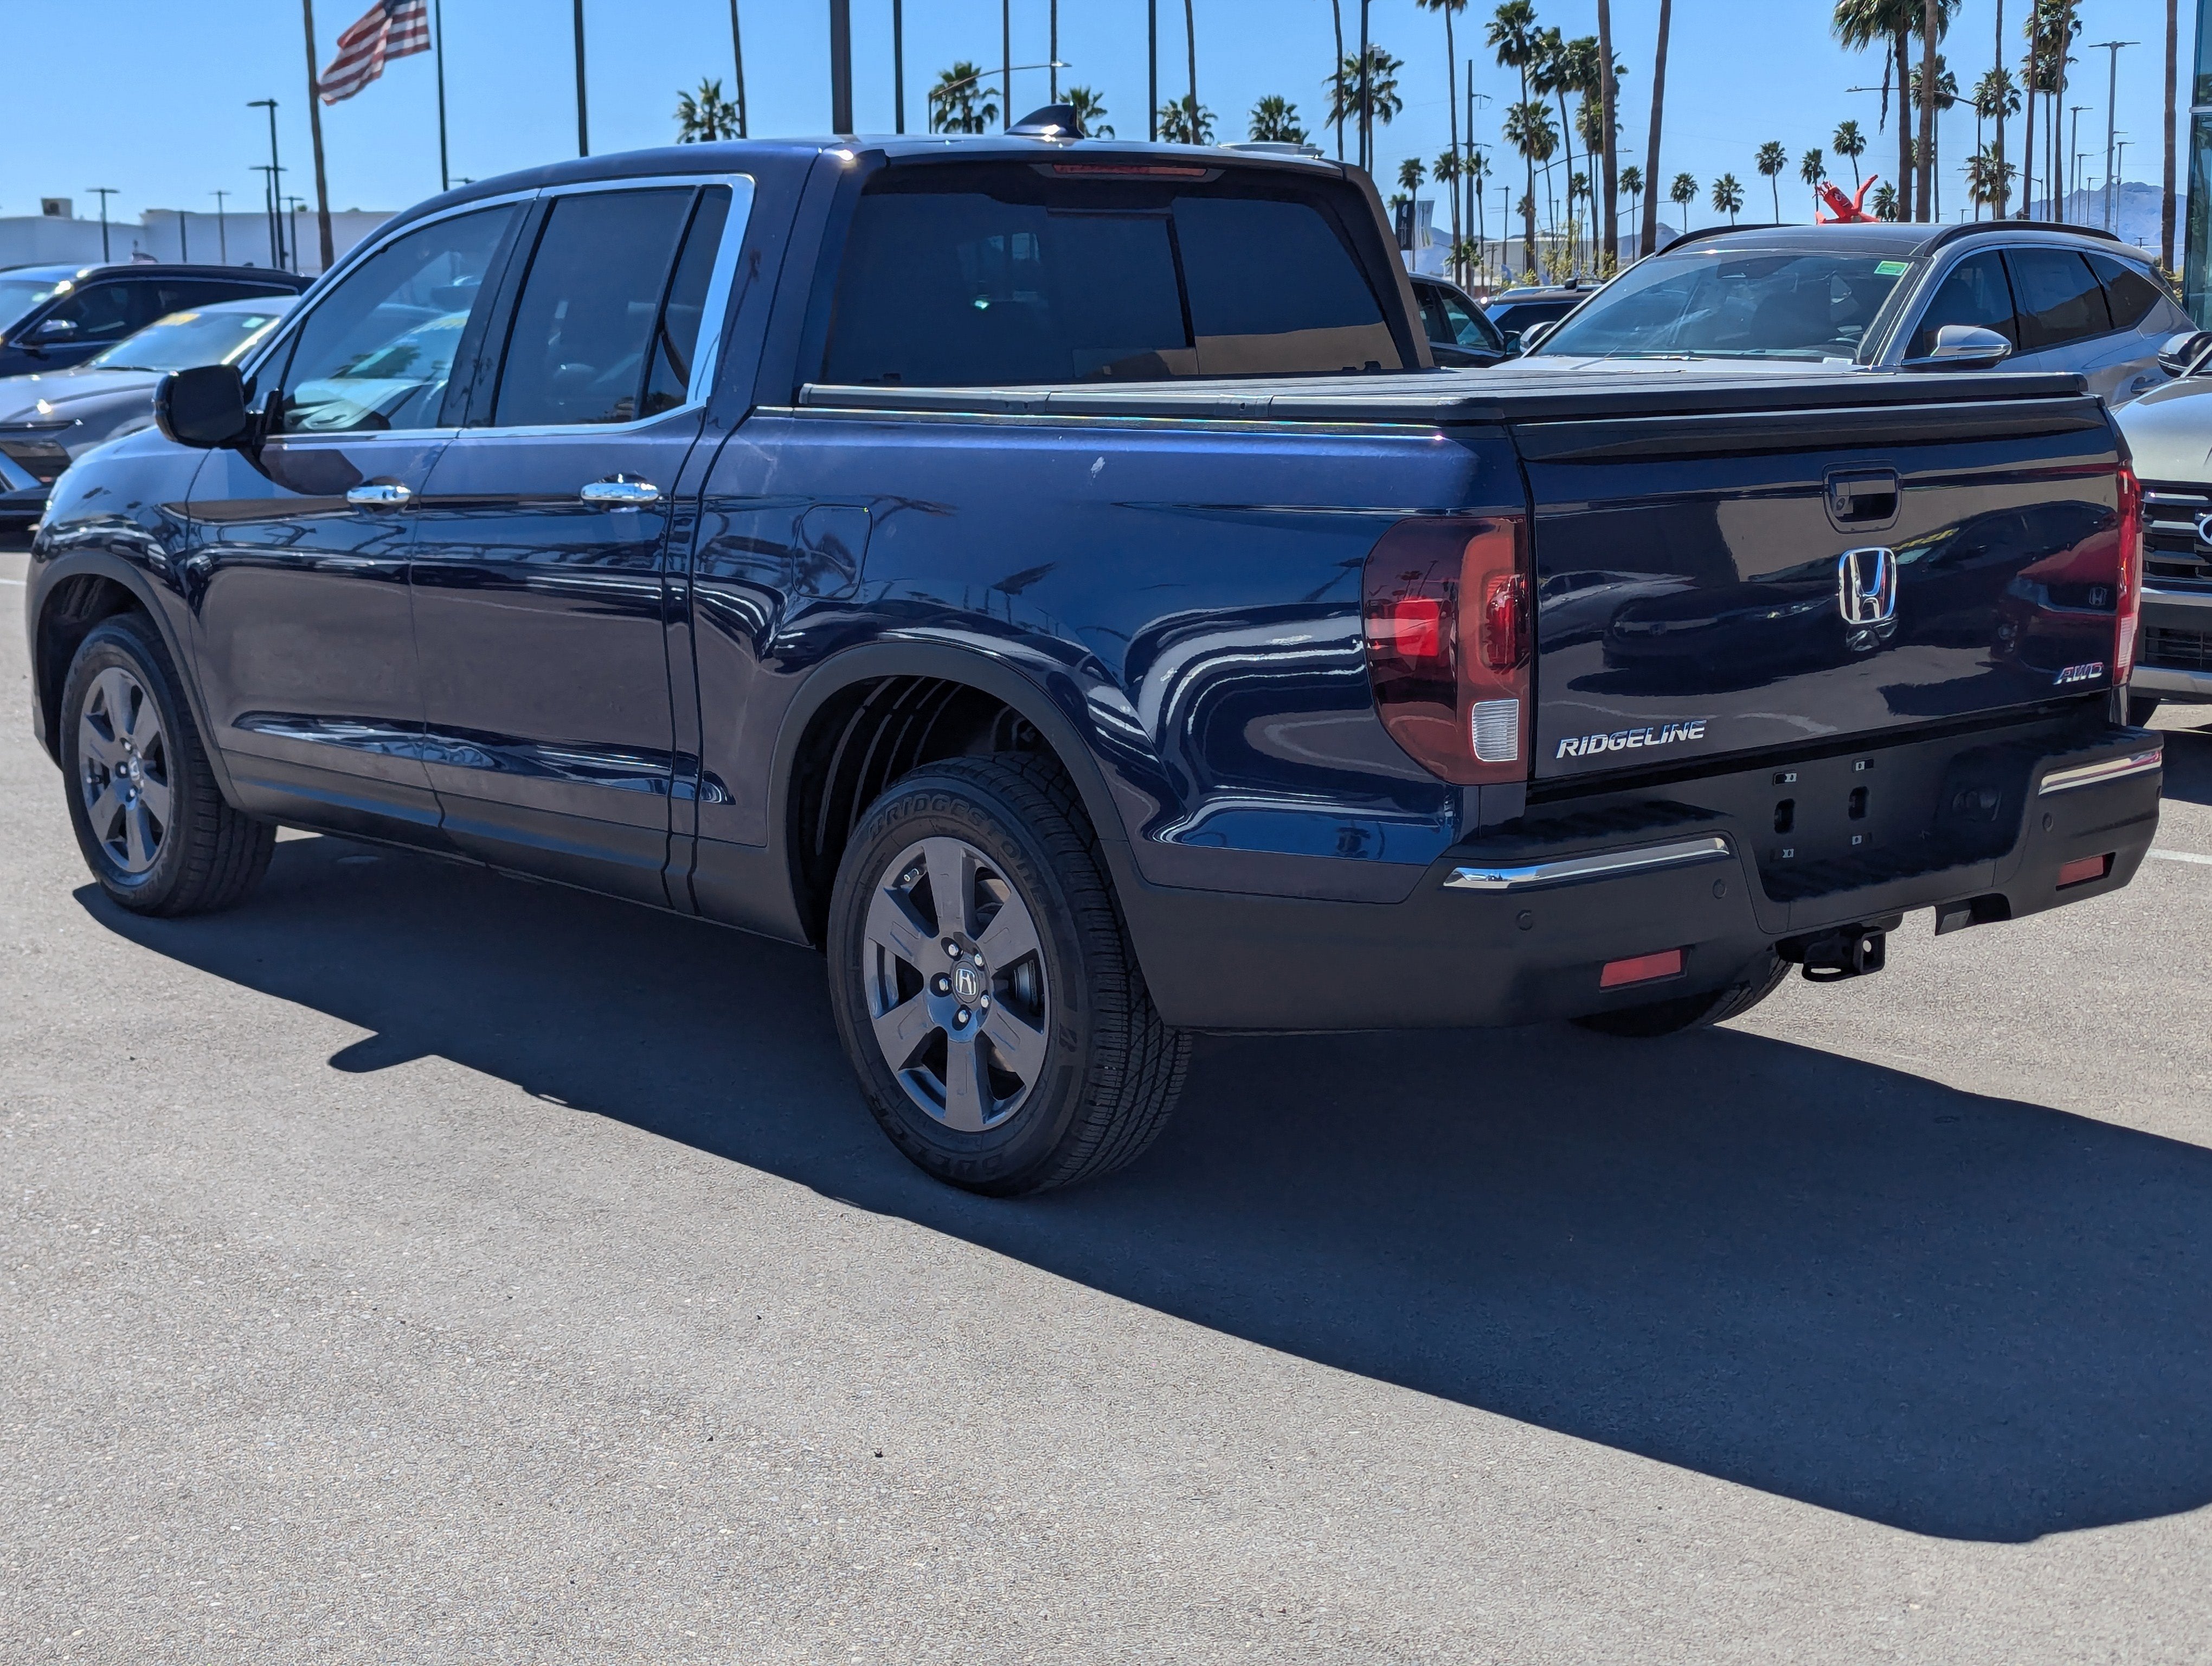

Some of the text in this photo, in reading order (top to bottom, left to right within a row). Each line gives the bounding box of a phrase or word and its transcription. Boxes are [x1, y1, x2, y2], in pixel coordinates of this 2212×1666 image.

[2053, 662, 2104, 685] AWD
[1555, 719, 1707, 759] RIDGELINE
[867, 793, 1047, 909] BRIDGESTONE
